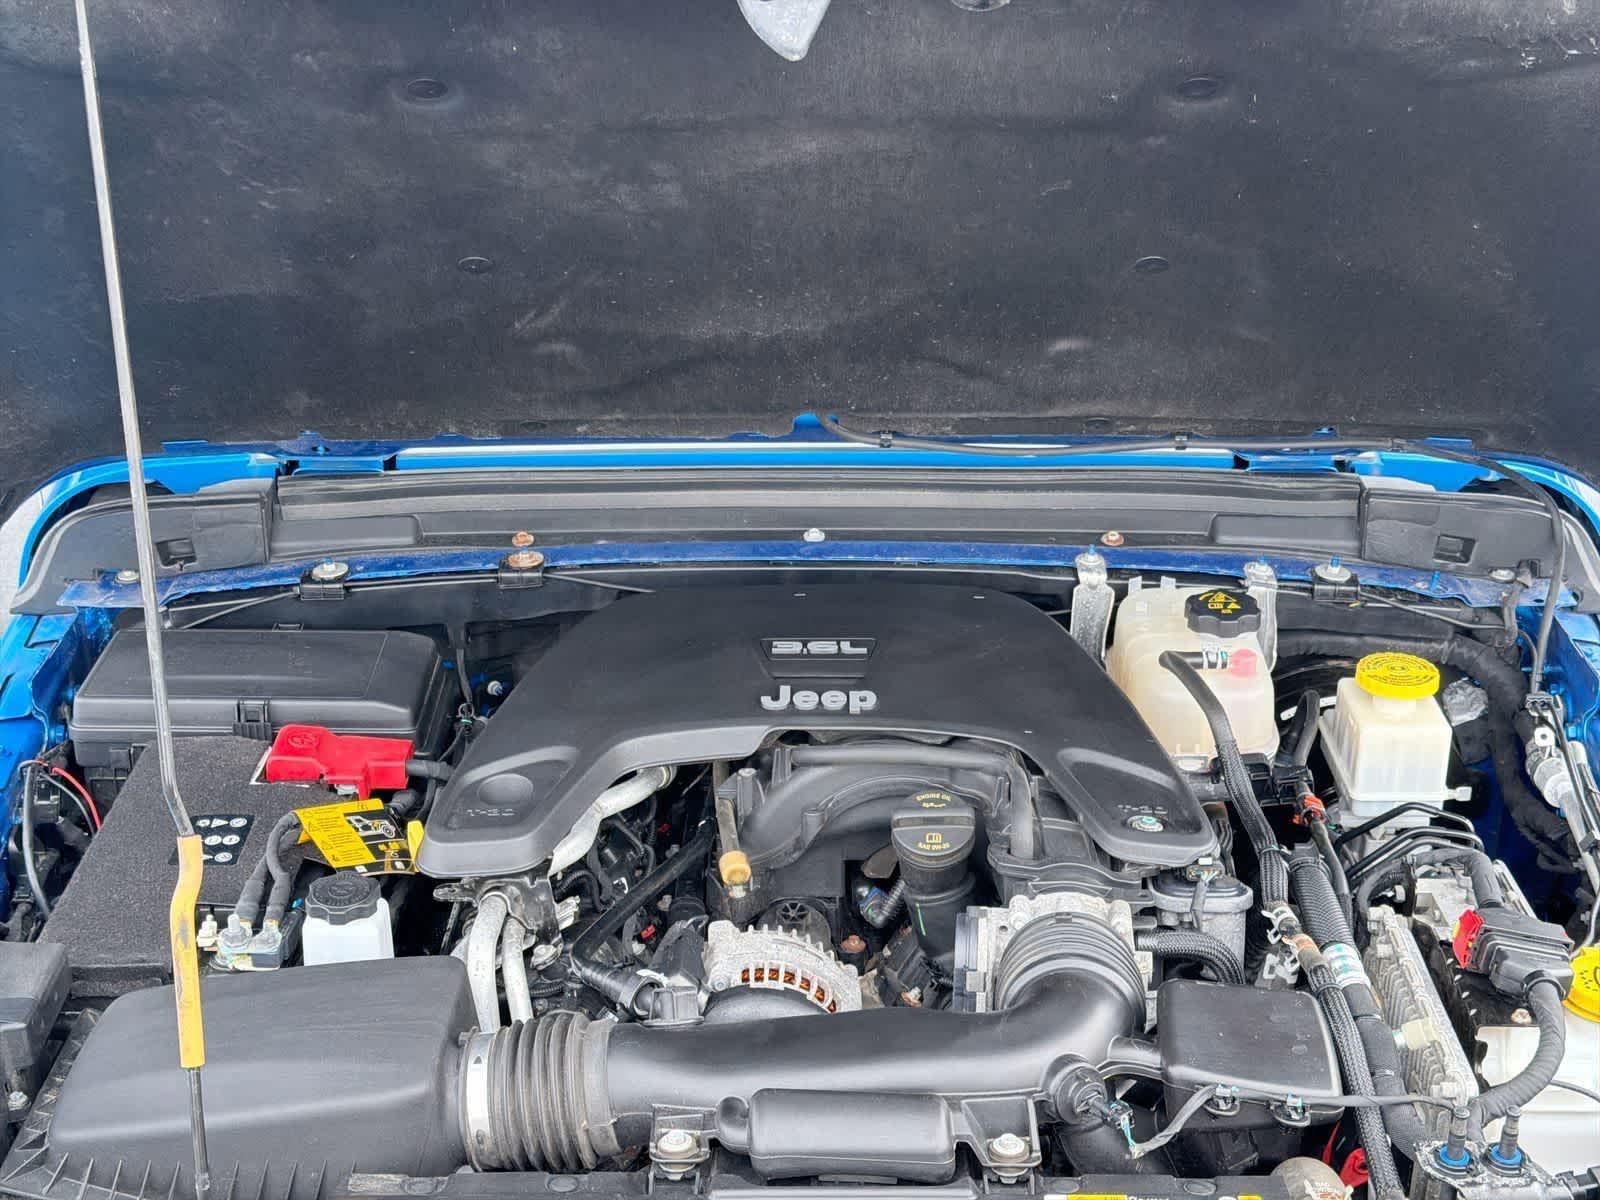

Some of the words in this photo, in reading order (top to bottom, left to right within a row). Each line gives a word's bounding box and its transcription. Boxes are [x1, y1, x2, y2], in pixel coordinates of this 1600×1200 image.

[771, 640, 868, 655] 3.6L
[760, 684, 877, 714] Jeep
[916, 792, 940, 802] ENGINE
